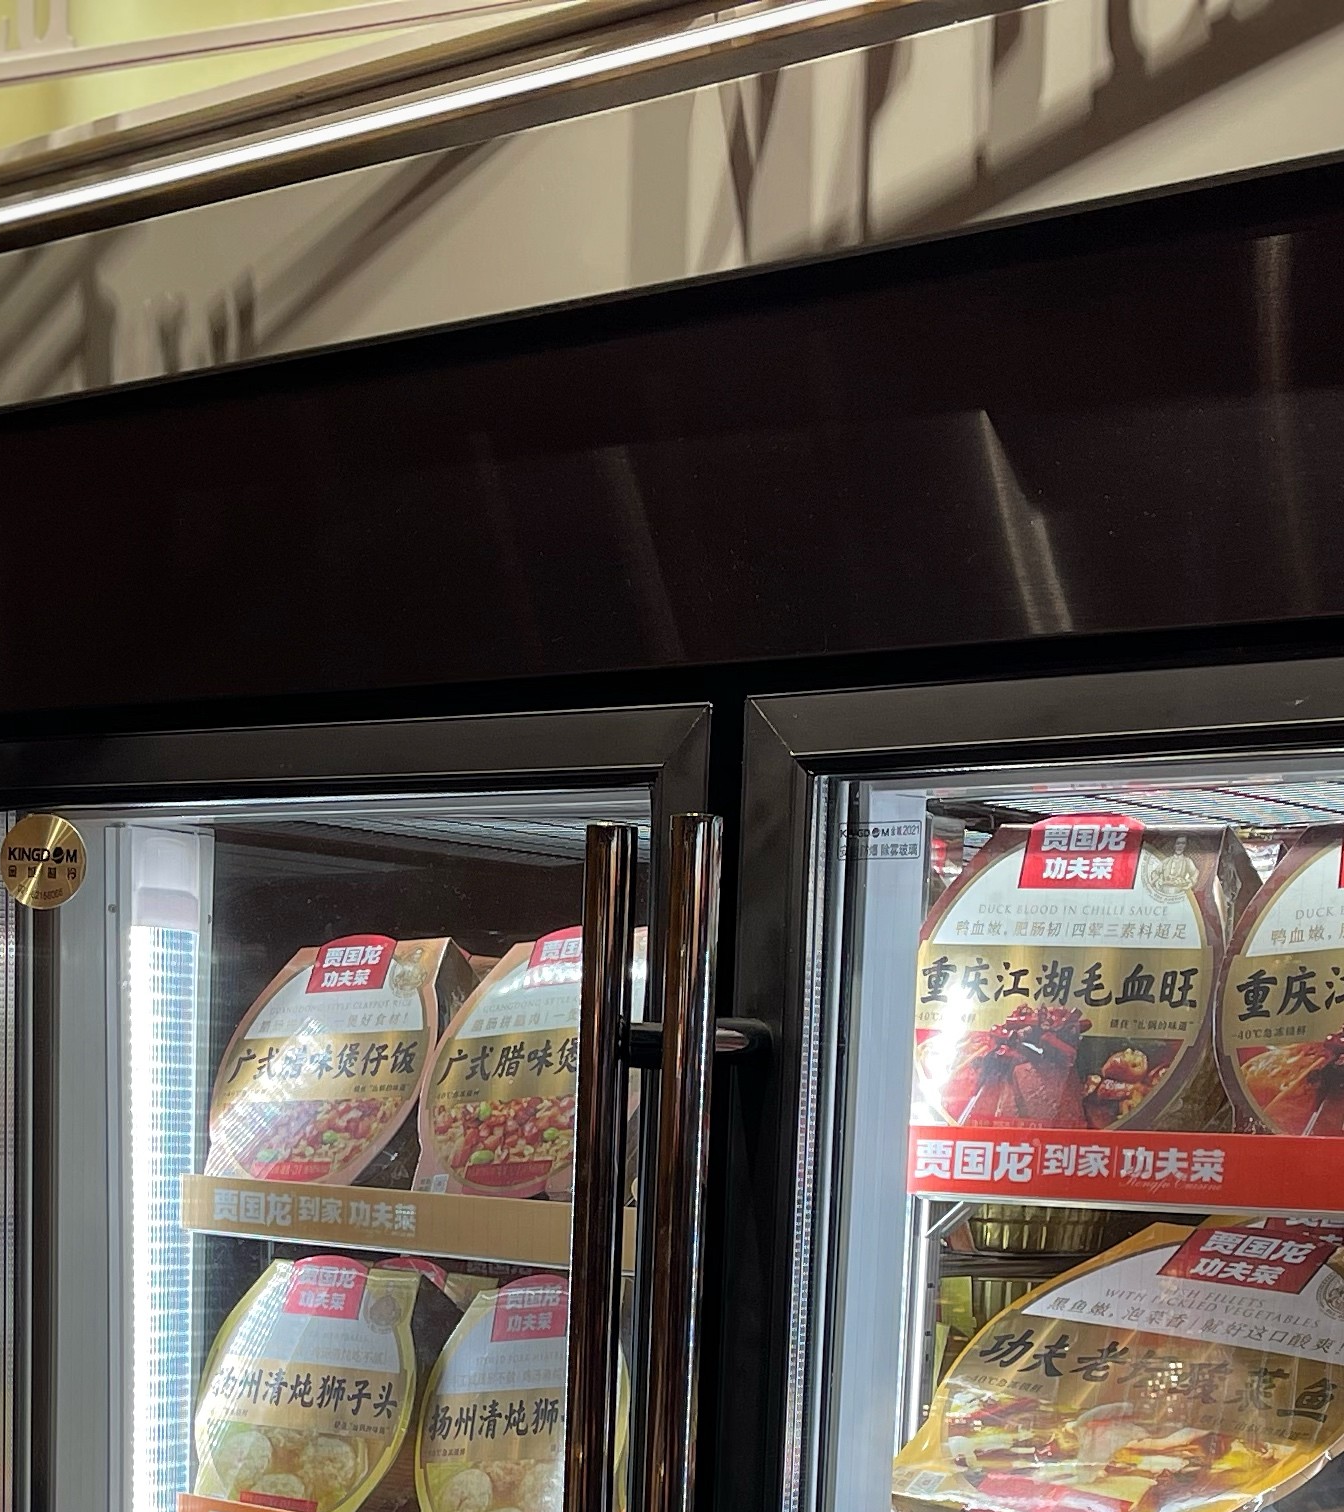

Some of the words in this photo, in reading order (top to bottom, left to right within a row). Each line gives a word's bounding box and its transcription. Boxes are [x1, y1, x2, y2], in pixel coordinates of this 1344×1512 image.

[1041, 824, 1130, 851] 贾国龙
[1043, 858, 1114, 880] 功夫菜
[979, 904, 1011, 915] DUCK
[1017, 905, 1057, 915] BLOOD
[1063, 905, 1076, 915] IN
[1083, 905, 1124, 916] CHILLI
[1130, 905, 1168, 917] SAUCE
[1295, 906, 1334, 920] DUCK
[323, 945, 383, 968] 贾国龙
[321, 969, 369, 988] 功夫菜
[920, 956, 1199, 1008] 重庆江湖毛血旺
[437, 1038, 578, 1085] 广式腊味煲
[914, 1140, 1035, 1182] 贾国龙
[1042, 1144, 1110, 1178] 到家
[1120, 1147, 1225, 1184] 功夫菜
[213, 1188, 292, 1226] 贾国龙
[298, 1196, 343, 1224] 到家
[349, 1202, 416, 1232] 功夫菜
[1200, 1230, 1316, 1264] 贾国龙
[1190, 1258, 1285, 1286] 功夫菜
[1106, 1288, 1144, 1301] WITH
[1224, 1303, 1321, 1329] VEGETABLES
[1205, 1292, 1264, 1307] FILLETS
[430, 1398, 564, 1440] 扬州清炖狮
